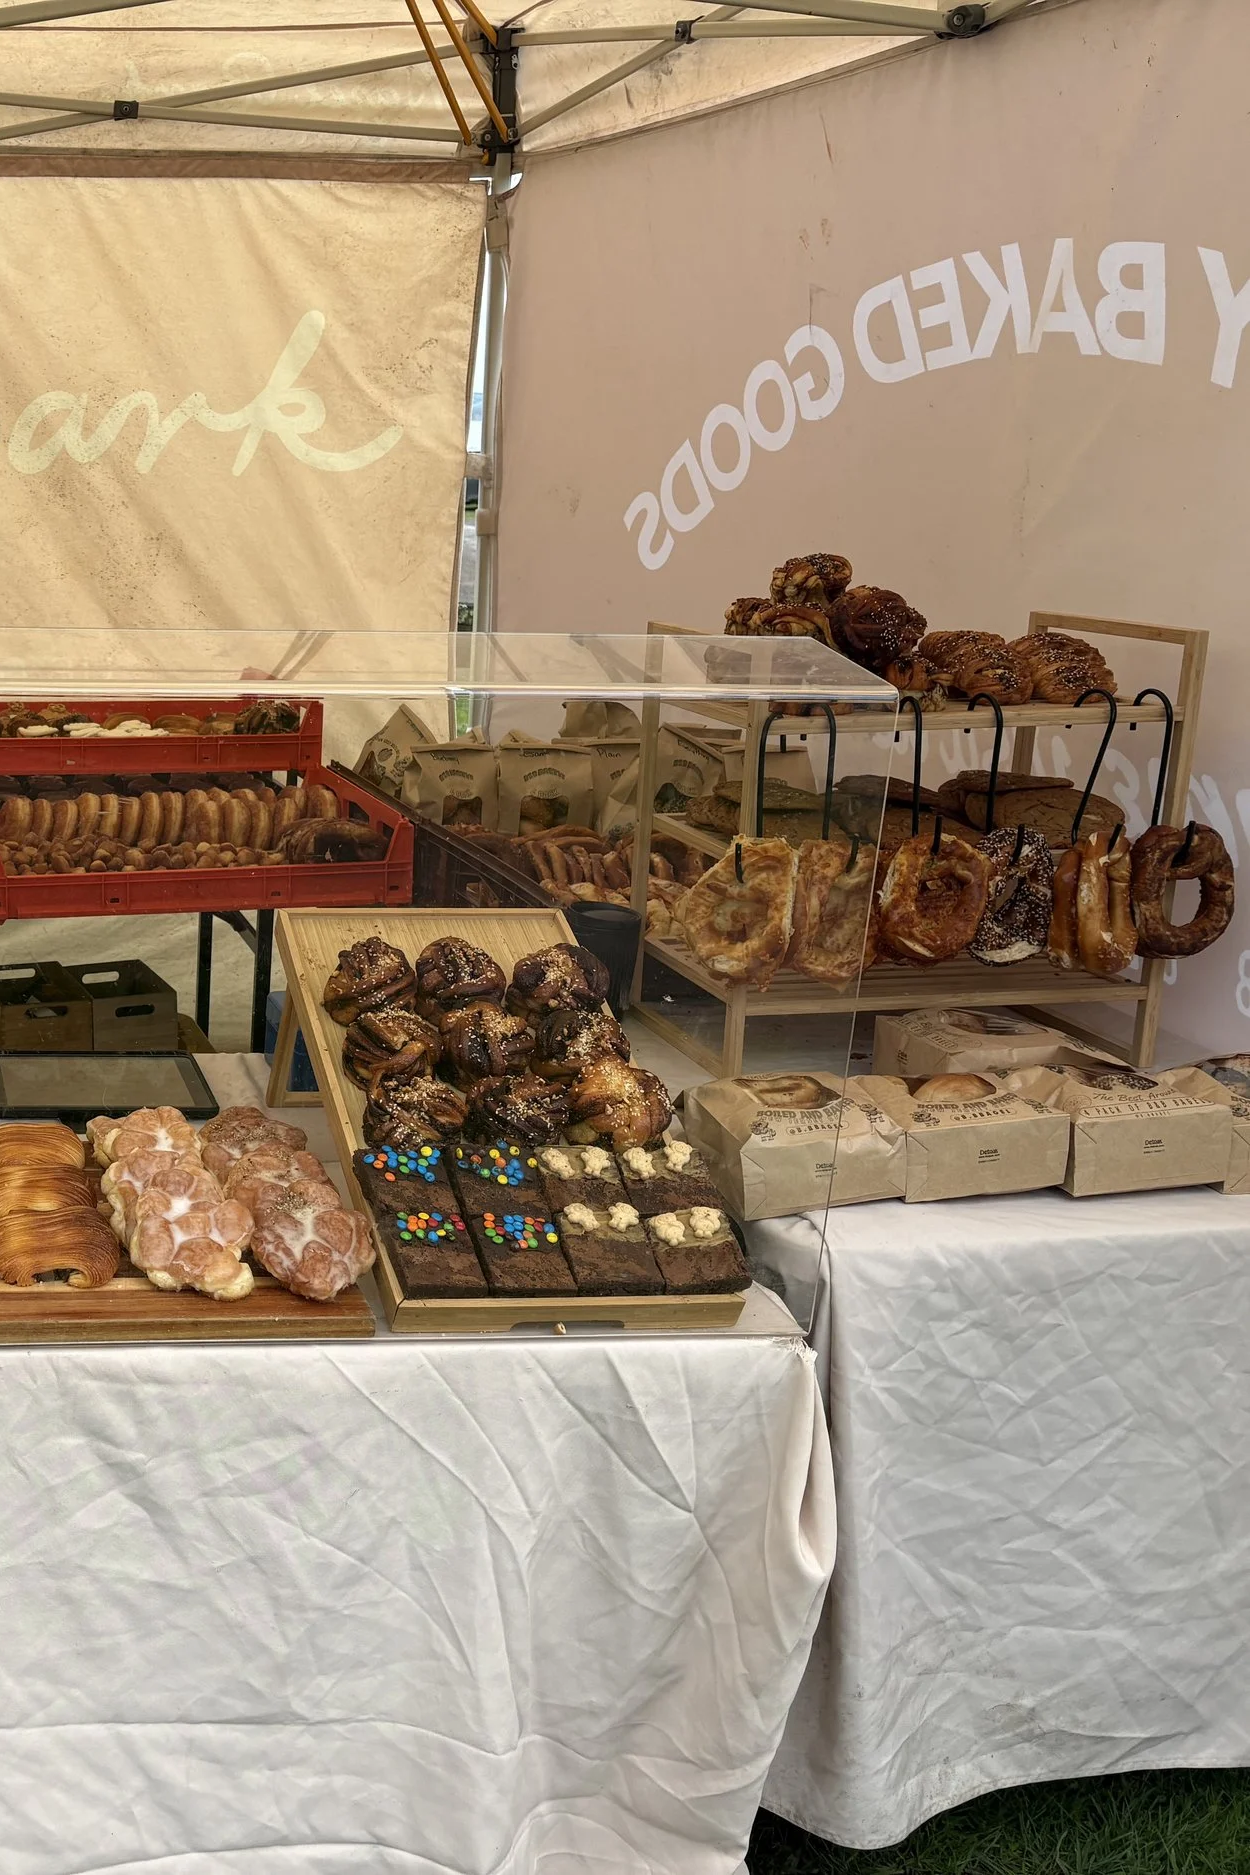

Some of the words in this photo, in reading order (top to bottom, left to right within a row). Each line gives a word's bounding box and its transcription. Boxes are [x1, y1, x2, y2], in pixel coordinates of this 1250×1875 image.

[596, 747, 622, 759] Plain
[1093, 1093, 1114, 1101] The
[1117, 1094, 1143, 1102] Best
[800, 1110, 824, 1119] AND
[1096, 1106, 1122, 1116] PACK
[1128, 1103, 1140, 1112] OF
